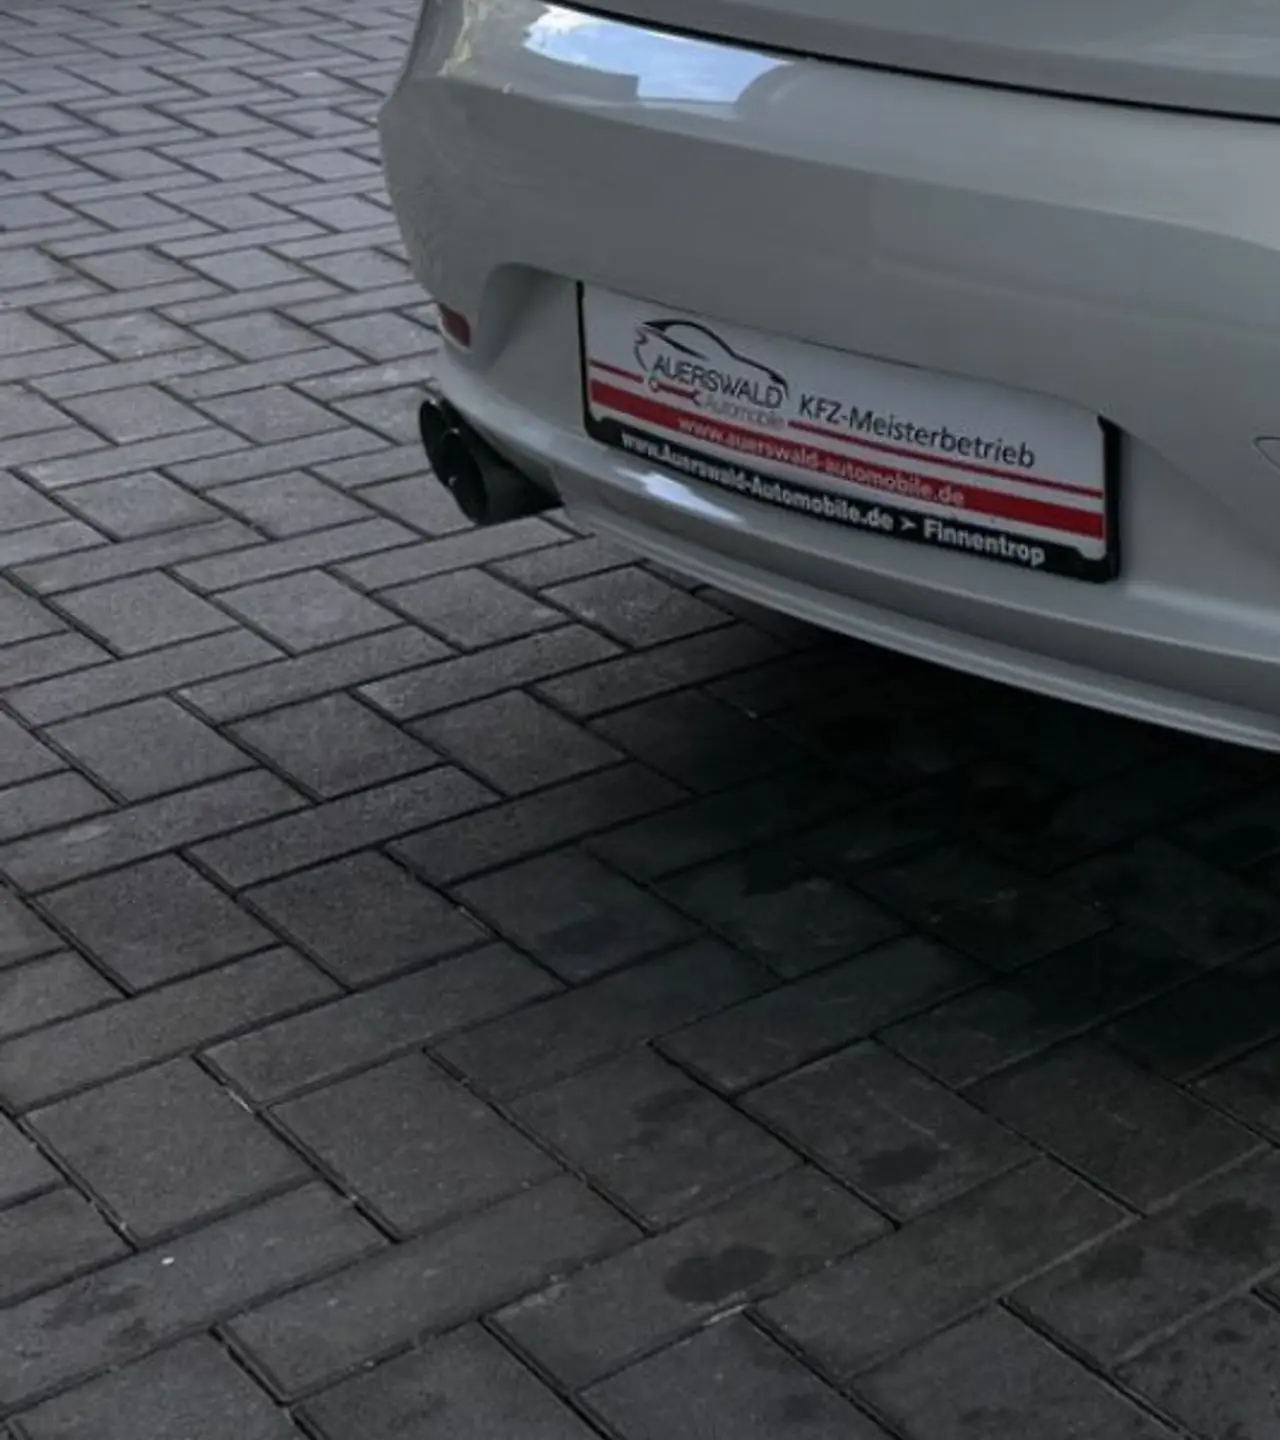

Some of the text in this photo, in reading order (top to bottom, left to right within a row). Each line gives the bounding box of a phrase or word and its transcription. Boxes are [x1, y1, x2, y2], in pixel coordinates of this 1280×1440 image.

[652, 353, 784, 409] AUERSWALD
[676, 416, 966, 508] www.auerswald-automobile.de
[799, 393, 1036, 469] KFZ-Meisterbetrieb
[620, 429, 1046, 567] www.Auerswald-Automobile.de Finnentrop
